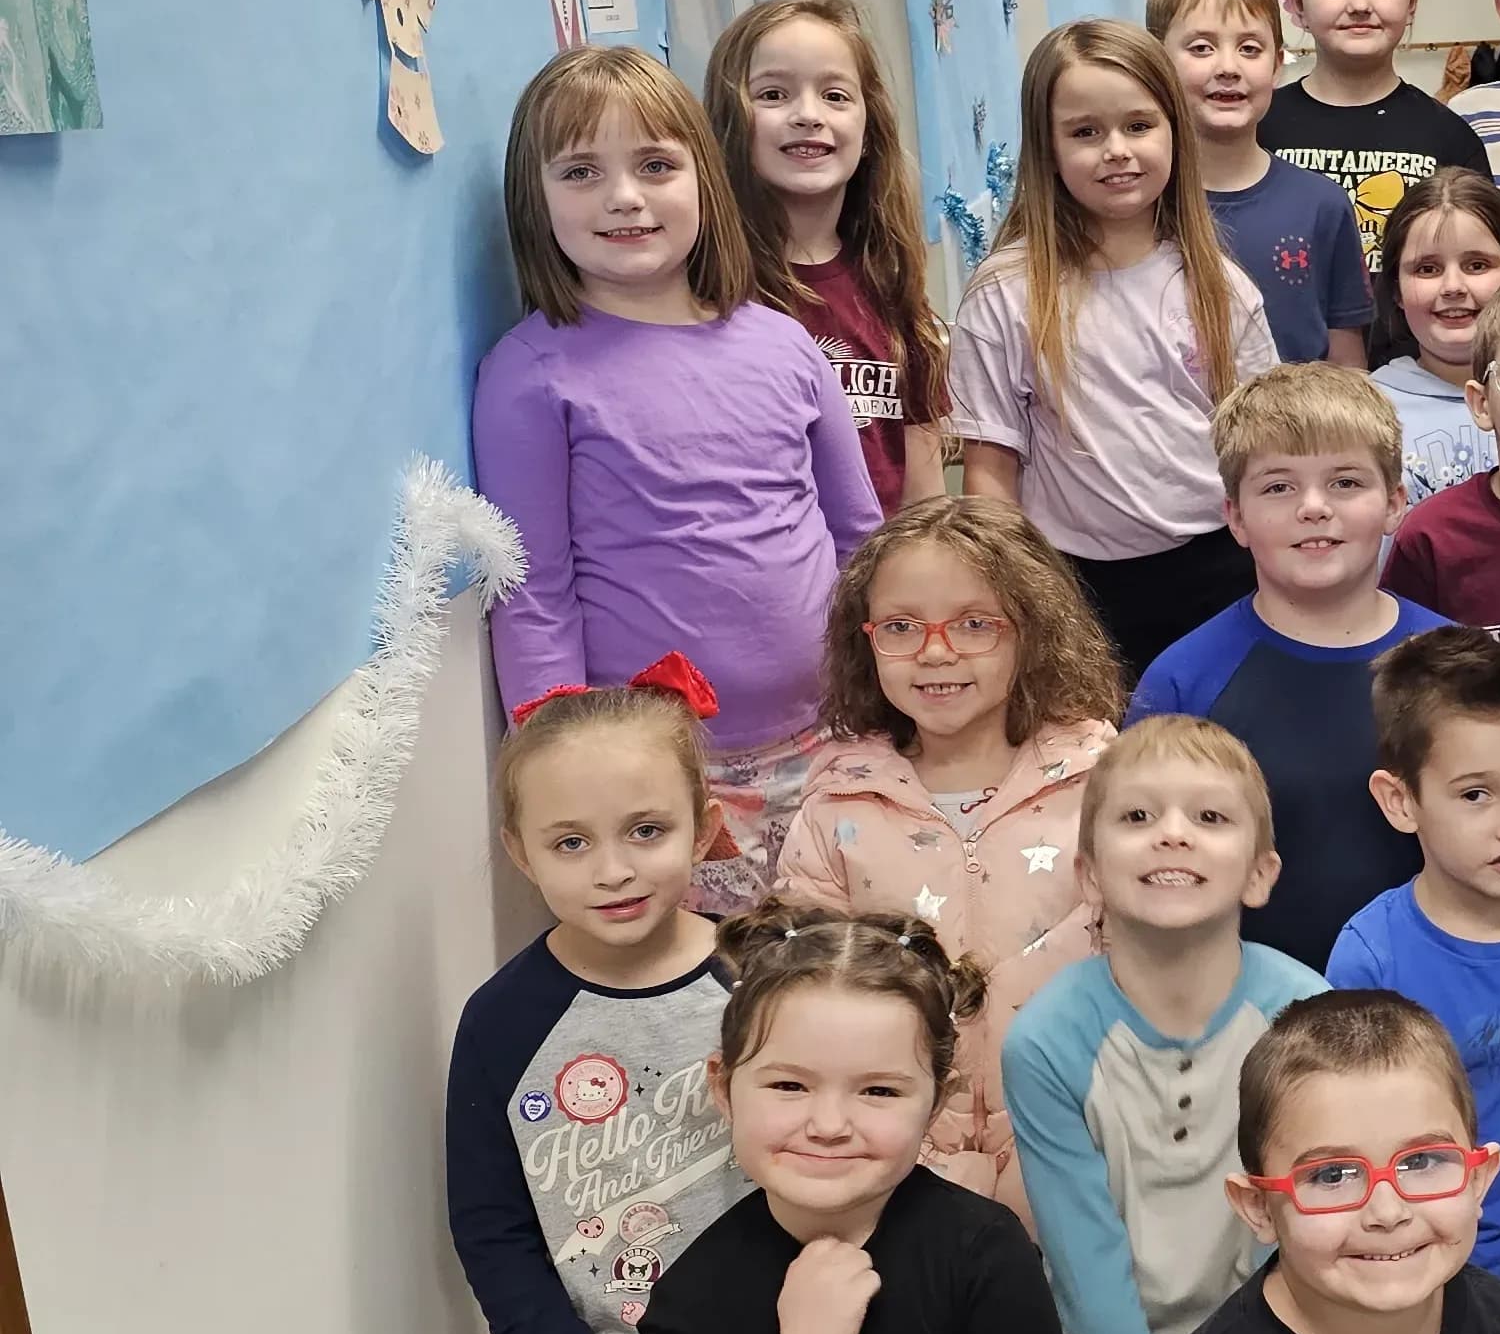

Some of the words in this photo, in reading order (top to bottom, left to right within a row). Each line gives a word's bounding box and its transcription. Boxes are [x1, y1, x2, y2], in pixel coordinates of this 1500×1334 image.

[832, 363, 898, 397] LIGH
[851, 400, 898, 416] ADEM
[525, 1106, 656, 1193] Hello
[565, 1158, 643, 1217] And
[646, 1116, 732, 1179] Frien
